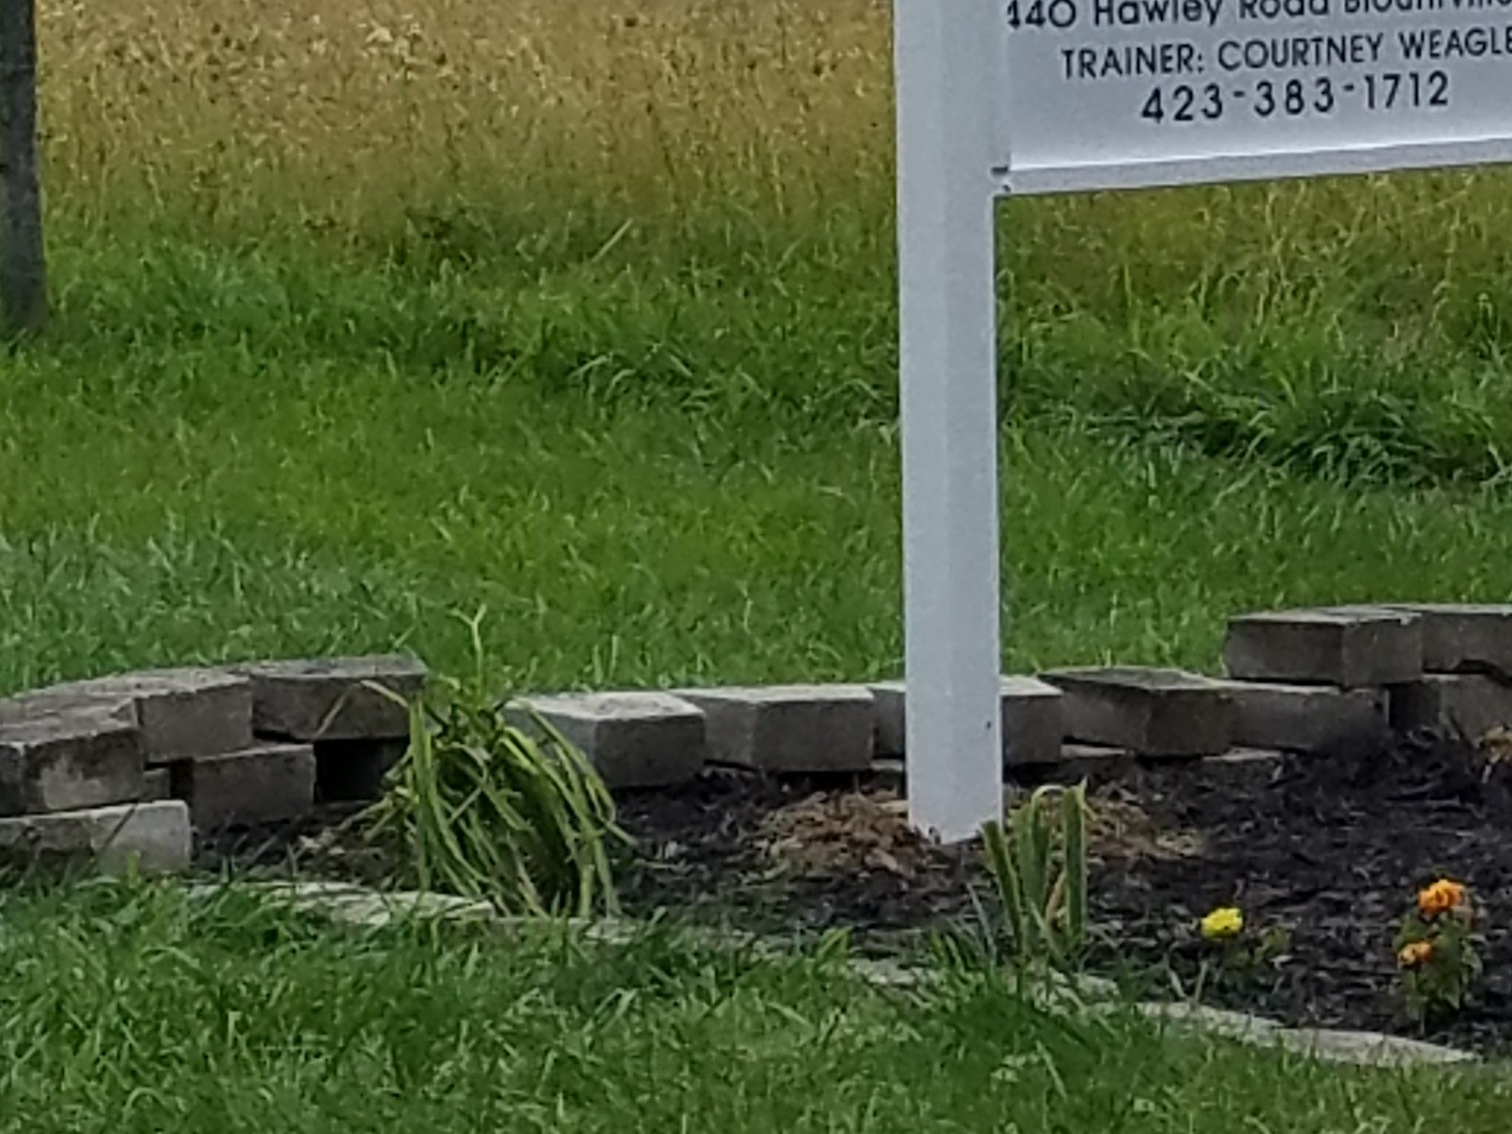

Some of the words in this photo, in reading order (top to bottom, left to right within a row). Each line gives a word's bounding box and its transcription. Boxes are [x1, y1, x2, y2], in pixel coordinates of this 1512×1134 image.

[1062, 43, 1204, 79] TRAINER:
[1217, 32, 1383, 71] COURTNEY
[1141, 70, 1448, 123] 423-383-1712
